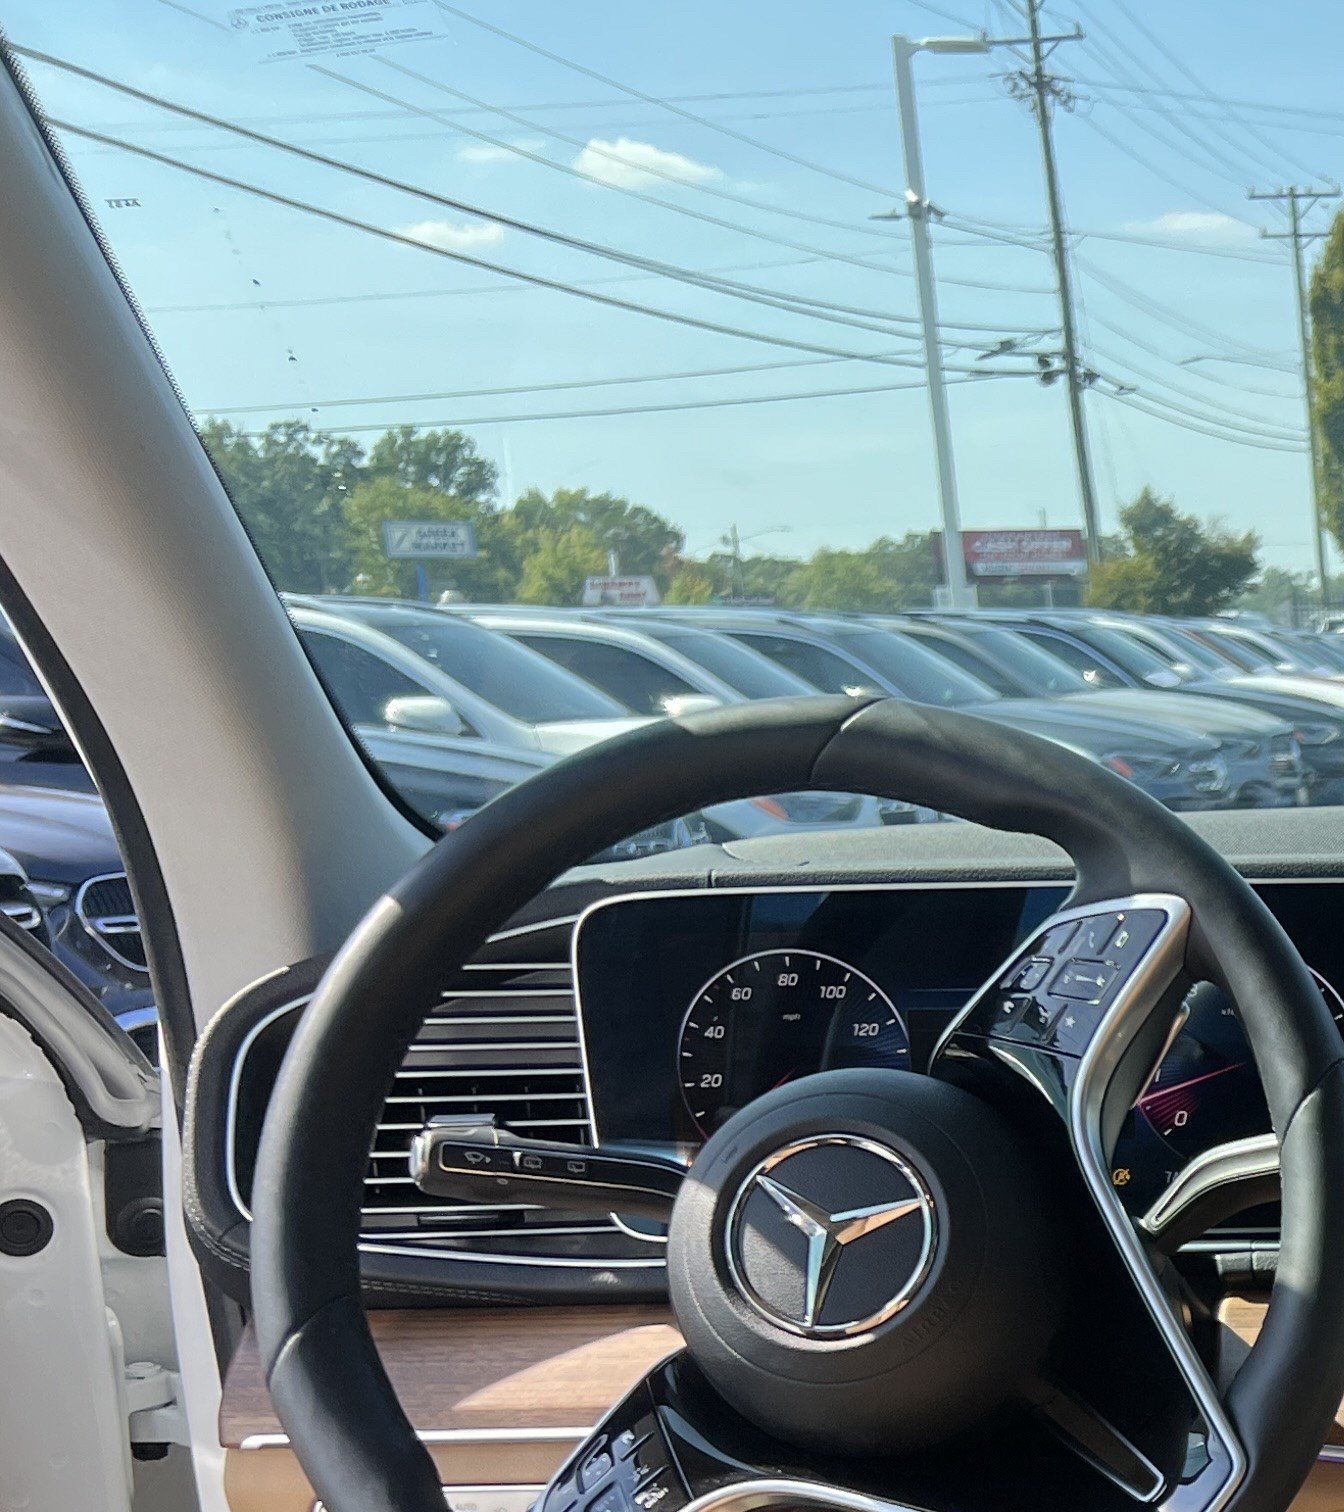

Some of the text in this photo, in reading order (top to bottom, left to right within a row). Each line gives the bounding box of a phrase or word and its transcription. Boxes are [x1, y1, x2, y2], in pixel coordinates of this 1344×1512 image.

[256, 8, 319, 23] CONSIGNE
[322, 3, 339, 14] DE
[778, 973, 798, 986] 80
[731, 987, 752, 1000] 60
[820, 986, 846, 999] 100
[783, 1013, 801, 1022] mph
[704, 1025, 725, 1039] 40
[853, 1023, 879, 1036] 120
[700, 1073, 722, 1088] 20
[1175, 1111, 1188, 1126] 0
